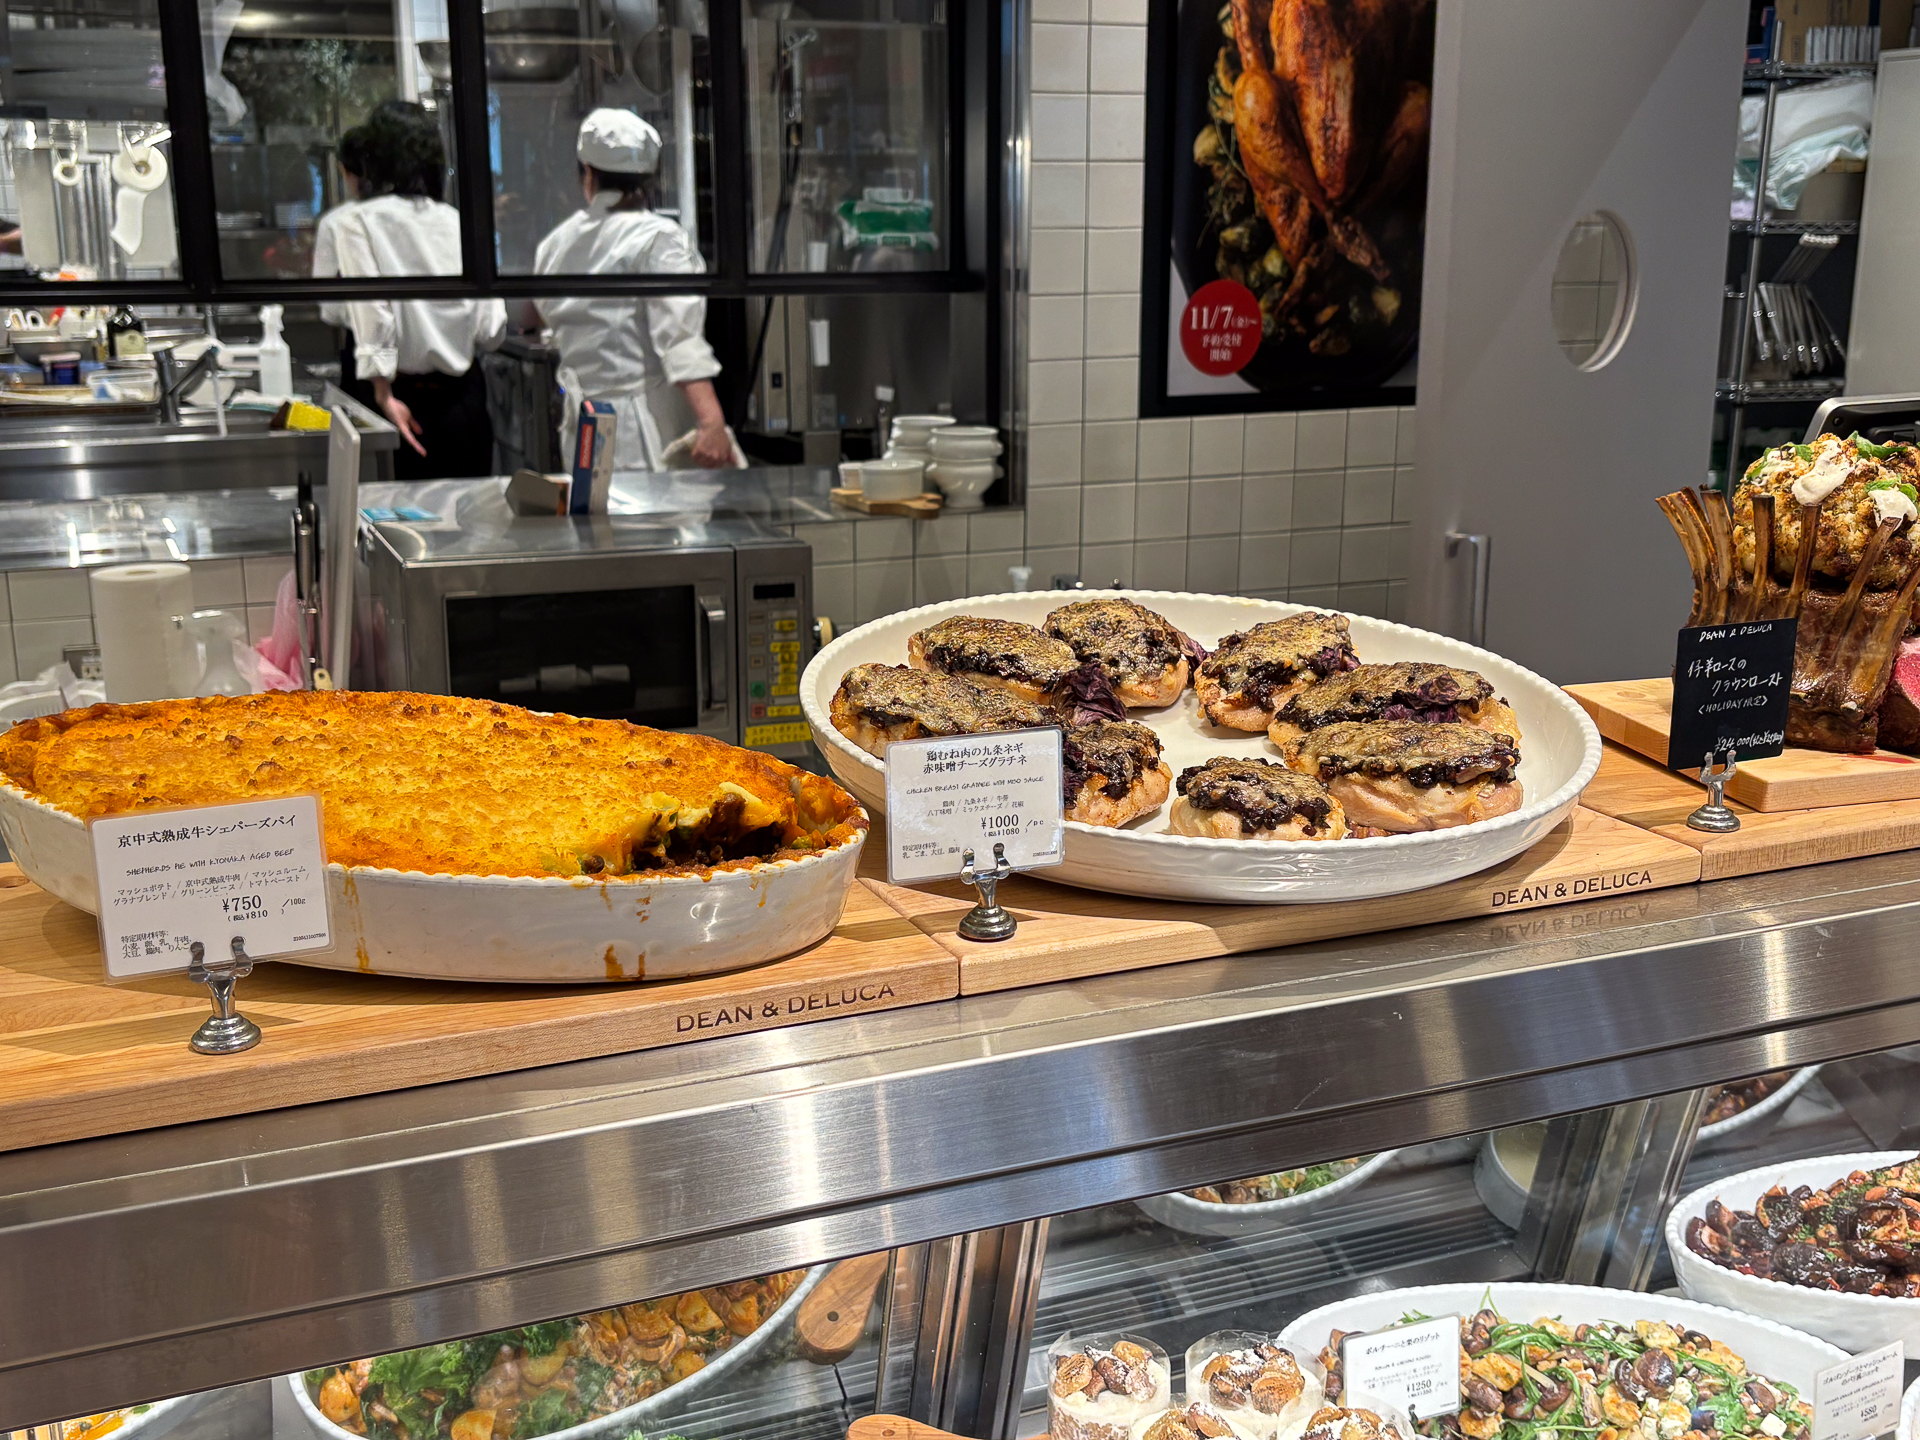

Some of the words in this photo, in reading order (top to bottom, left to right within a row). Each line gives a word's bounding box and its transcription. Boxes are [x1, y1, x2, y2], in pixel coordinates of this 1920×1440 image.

[1202, 333, 1242, 348] 予約受付
[1209, 348, 1232, 362] 開始
[1699, 629, 1726, 642] DEAN
[1740, 623, 1772, 635] DELUCA
[1711, 671, 1783, 697] クラウンロースト
[926, 743, 1024, 762] 鶏むね肉の九条ネギ
[923, 754, 1027, 774] 赤味噌チーズグラチネ
[906, 786, 933, 795] CHICKEN
[935, 784, 959, 792] BREAST
[962, 804, 1003, 813] ミックスチーズ
[117, 814, 296, 848] 京中式熟成牛シェパーズパイ
[981, 814, 1019, 829] ¥1000
[126, 864, 171, 877] SHEPHERDS
[174, 861, 187, 870] PIE
[189, 859, 206, 868] WITH
[209, 855, 246, 866] KYONAKA
[249, 851, 271, 860] AGED
[274, 848, 295, 857] BEEF
[118, 883, 172, 896] マッシュポテト
[252, 866, 306, 878] マッシュルーム
[1492, 885, 1548, 907] DEAN
[1554, 883, 1567, 897] &
[1573, 870, 1652, 895] DELUCA
[113, 892, 167, 906] グラナブレンド
[222, 895, 262, 913] ¥750
[676, 1005, 753, 1032] DEAN
[762, 1001, 779, 1018] &
[788, 983, 895, 1014] DELUCA
[1406, 1379, 1431, 1392] ¥1250
